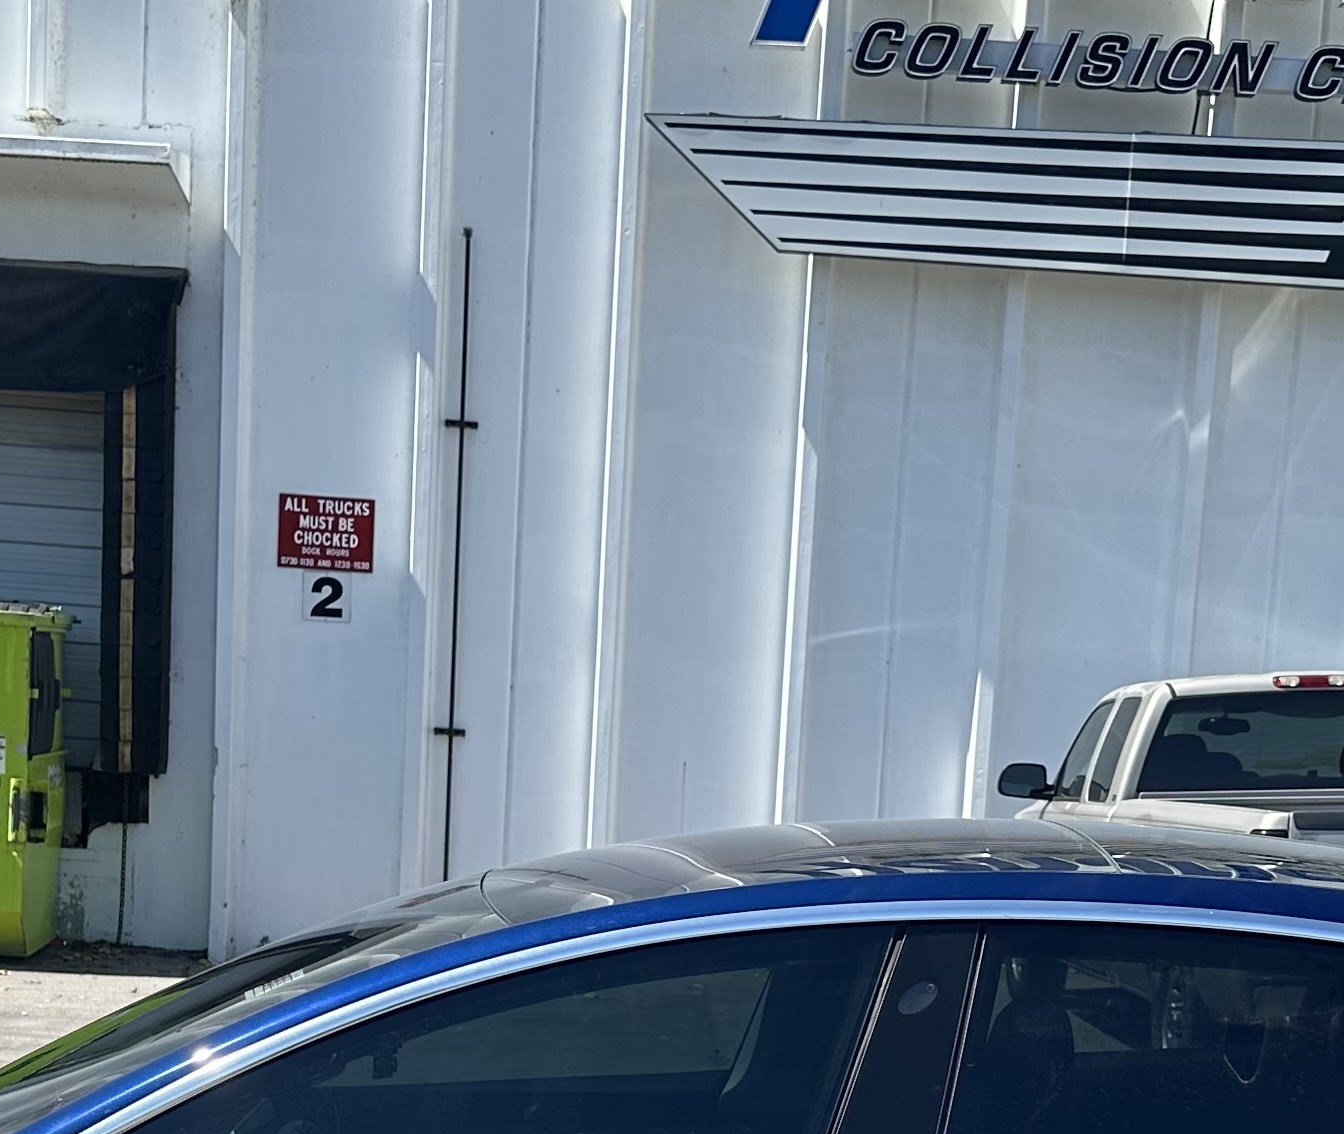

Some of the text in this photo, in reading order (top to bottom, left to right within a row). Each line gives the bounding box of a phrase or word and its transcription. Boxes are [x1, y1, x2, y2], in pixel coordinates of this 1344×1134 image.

[853, 18, 1274, 94] COLLISION
[284, 497, 370, 516] ALL TRUCKS
[299, 514, 355, 532] MUST BE
[293, 530, 359, 548] CHOCKED
[301, 547, 321, 556] DOCK
[310, 576, 343, 618] 2
